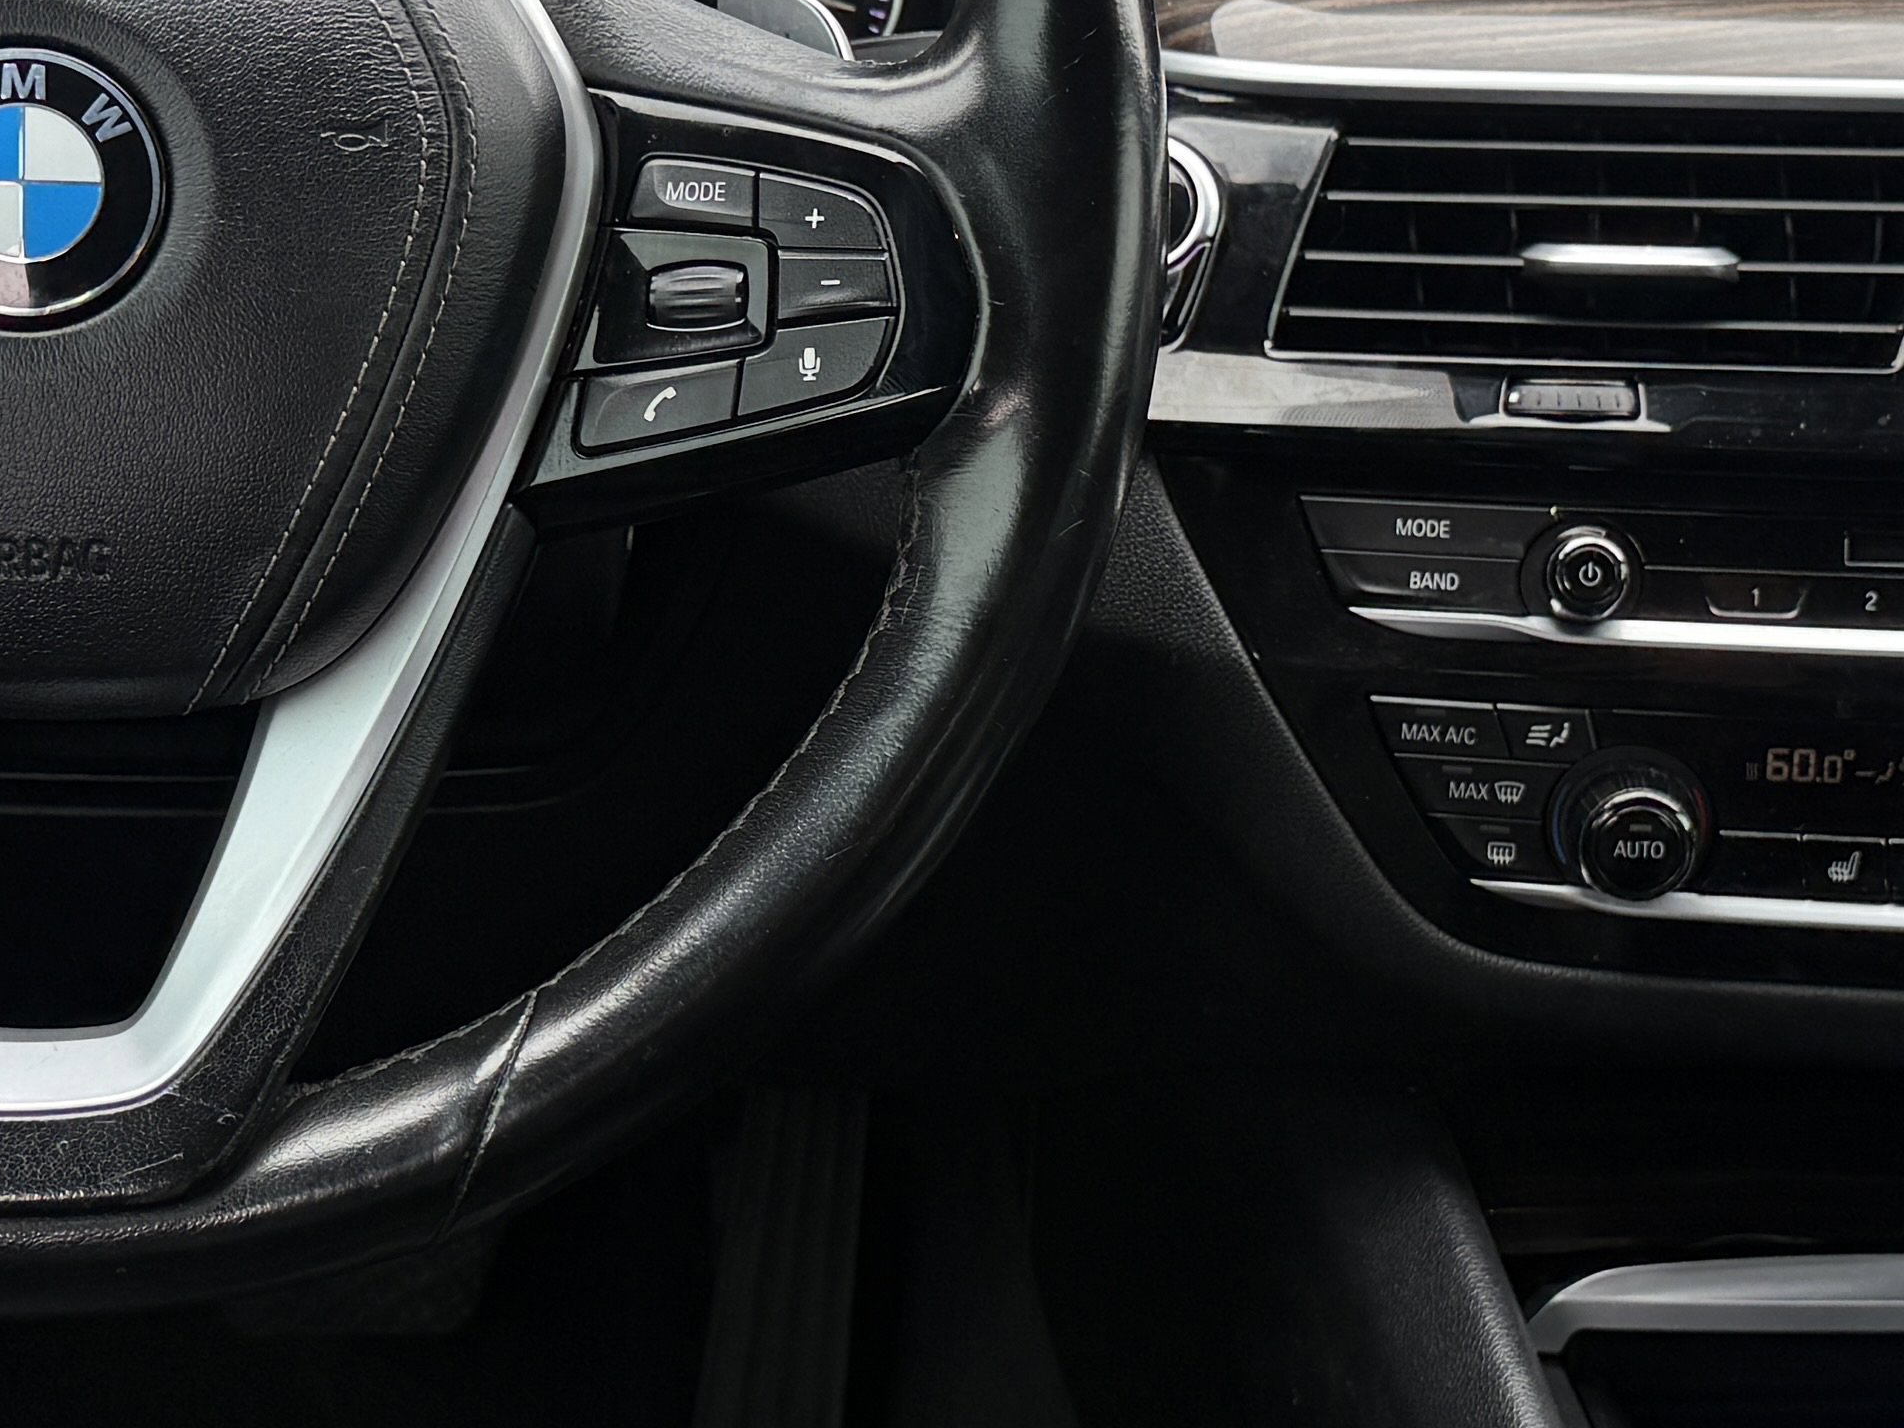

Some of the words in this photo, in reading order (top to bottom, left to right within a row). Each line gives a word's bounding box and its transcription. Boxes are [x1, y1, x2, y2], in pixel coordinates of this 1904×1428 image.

[665, 181, 727, 202] MODE
[1396, 517, 1451, 540] MODE
[1409, 570, 1460, 592] BAND
[1750, 586, 1761, 607] 1
[1864, 590, 1878, 612] 2
[1401, 723, 1441, 743] MAX
[1445, 726, 1477, 745] A/C
[1449, 781, 1488, 801] MAX
[1613, 840, 1665, 860] AUTO
